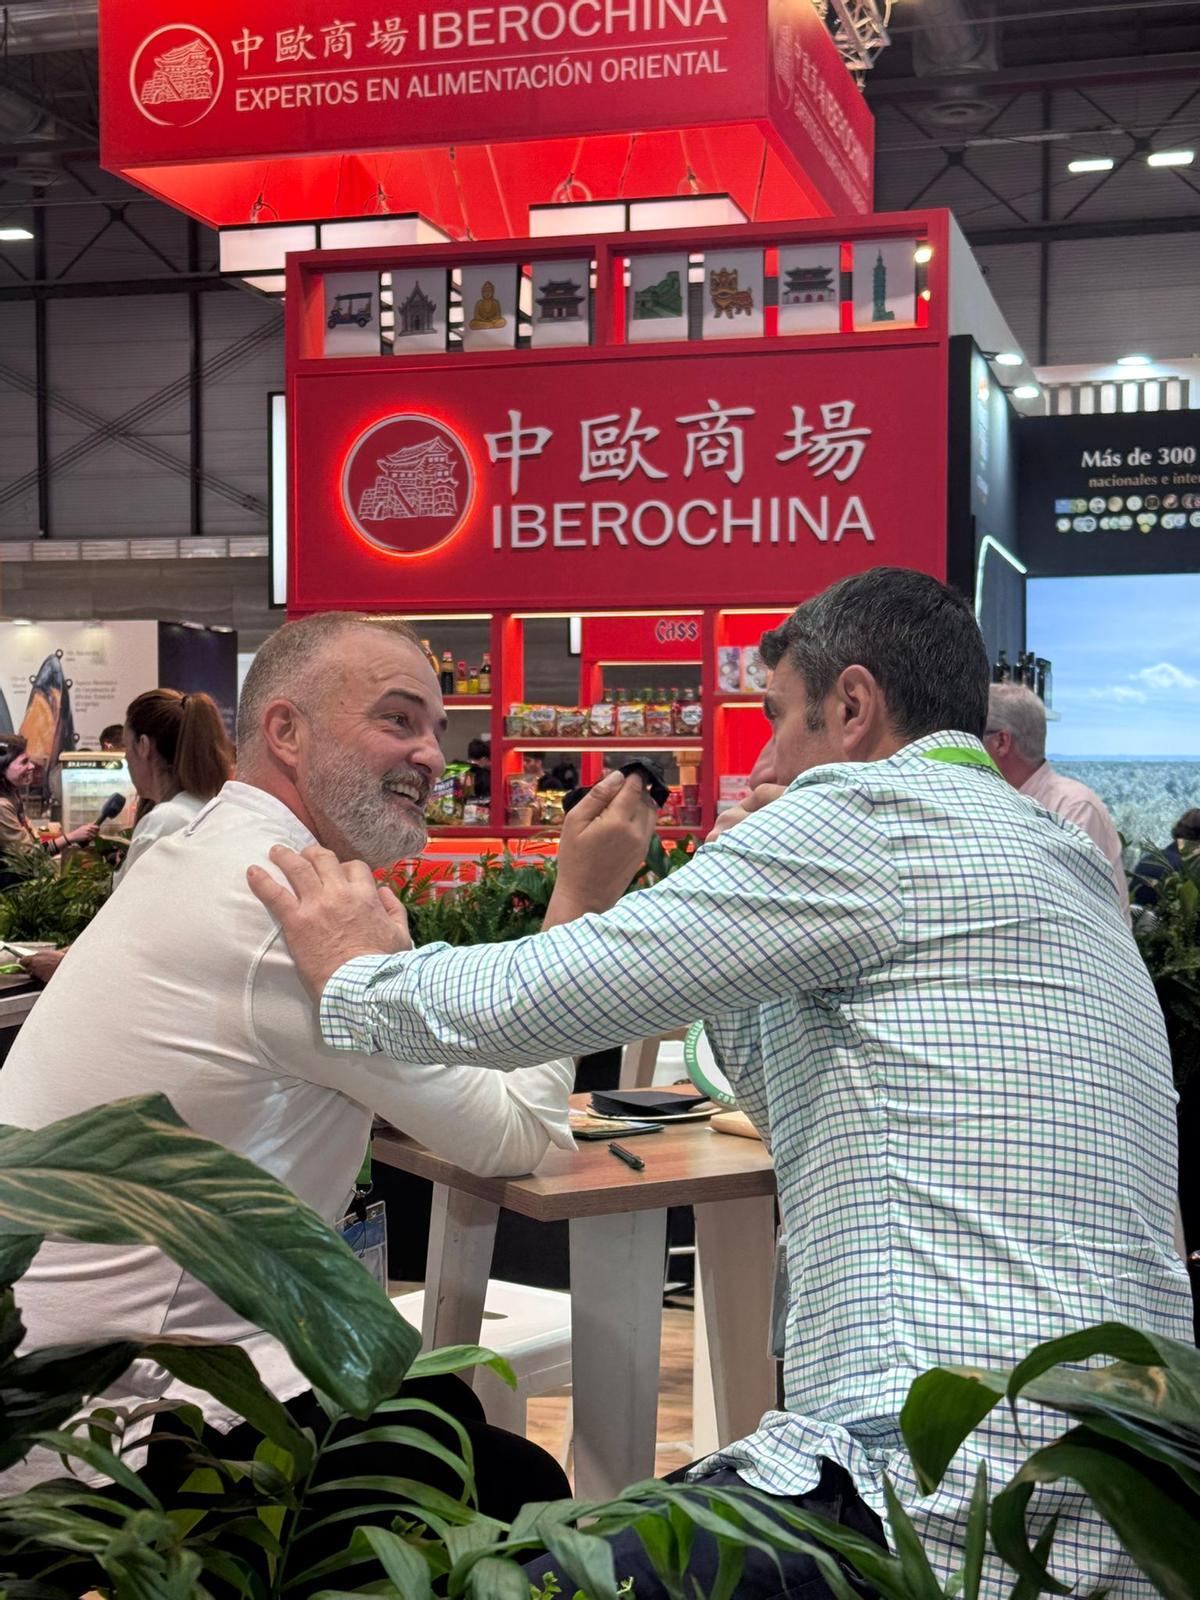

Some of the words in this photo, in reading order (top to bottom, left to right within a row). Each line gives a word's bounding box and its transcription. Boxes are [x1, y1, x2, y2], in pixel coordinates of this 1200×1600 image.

[231, 17, 409, 70] 中歐商場
[418, 0, 729, 50] IBEROCHINA
[234, 82, 360, 113] EXPERTOS
[367, 76, 400, 103] EN
[407, 58, 595, 99] ALIMENTACIÓN
[603, 49, 728, 82] ORIENTAL
[483, 399, 871, 496] 中歐商場
[1081, 448, 1122, 468] Más
[1127, 447, 1152, 466] de
[1158, 447, 1197, 465] 300
[1088, 474, 1158, 488] nacionales
[1161, 475, 1169, 485] e
[492, 496, 876, 549] IBEROCHINA
